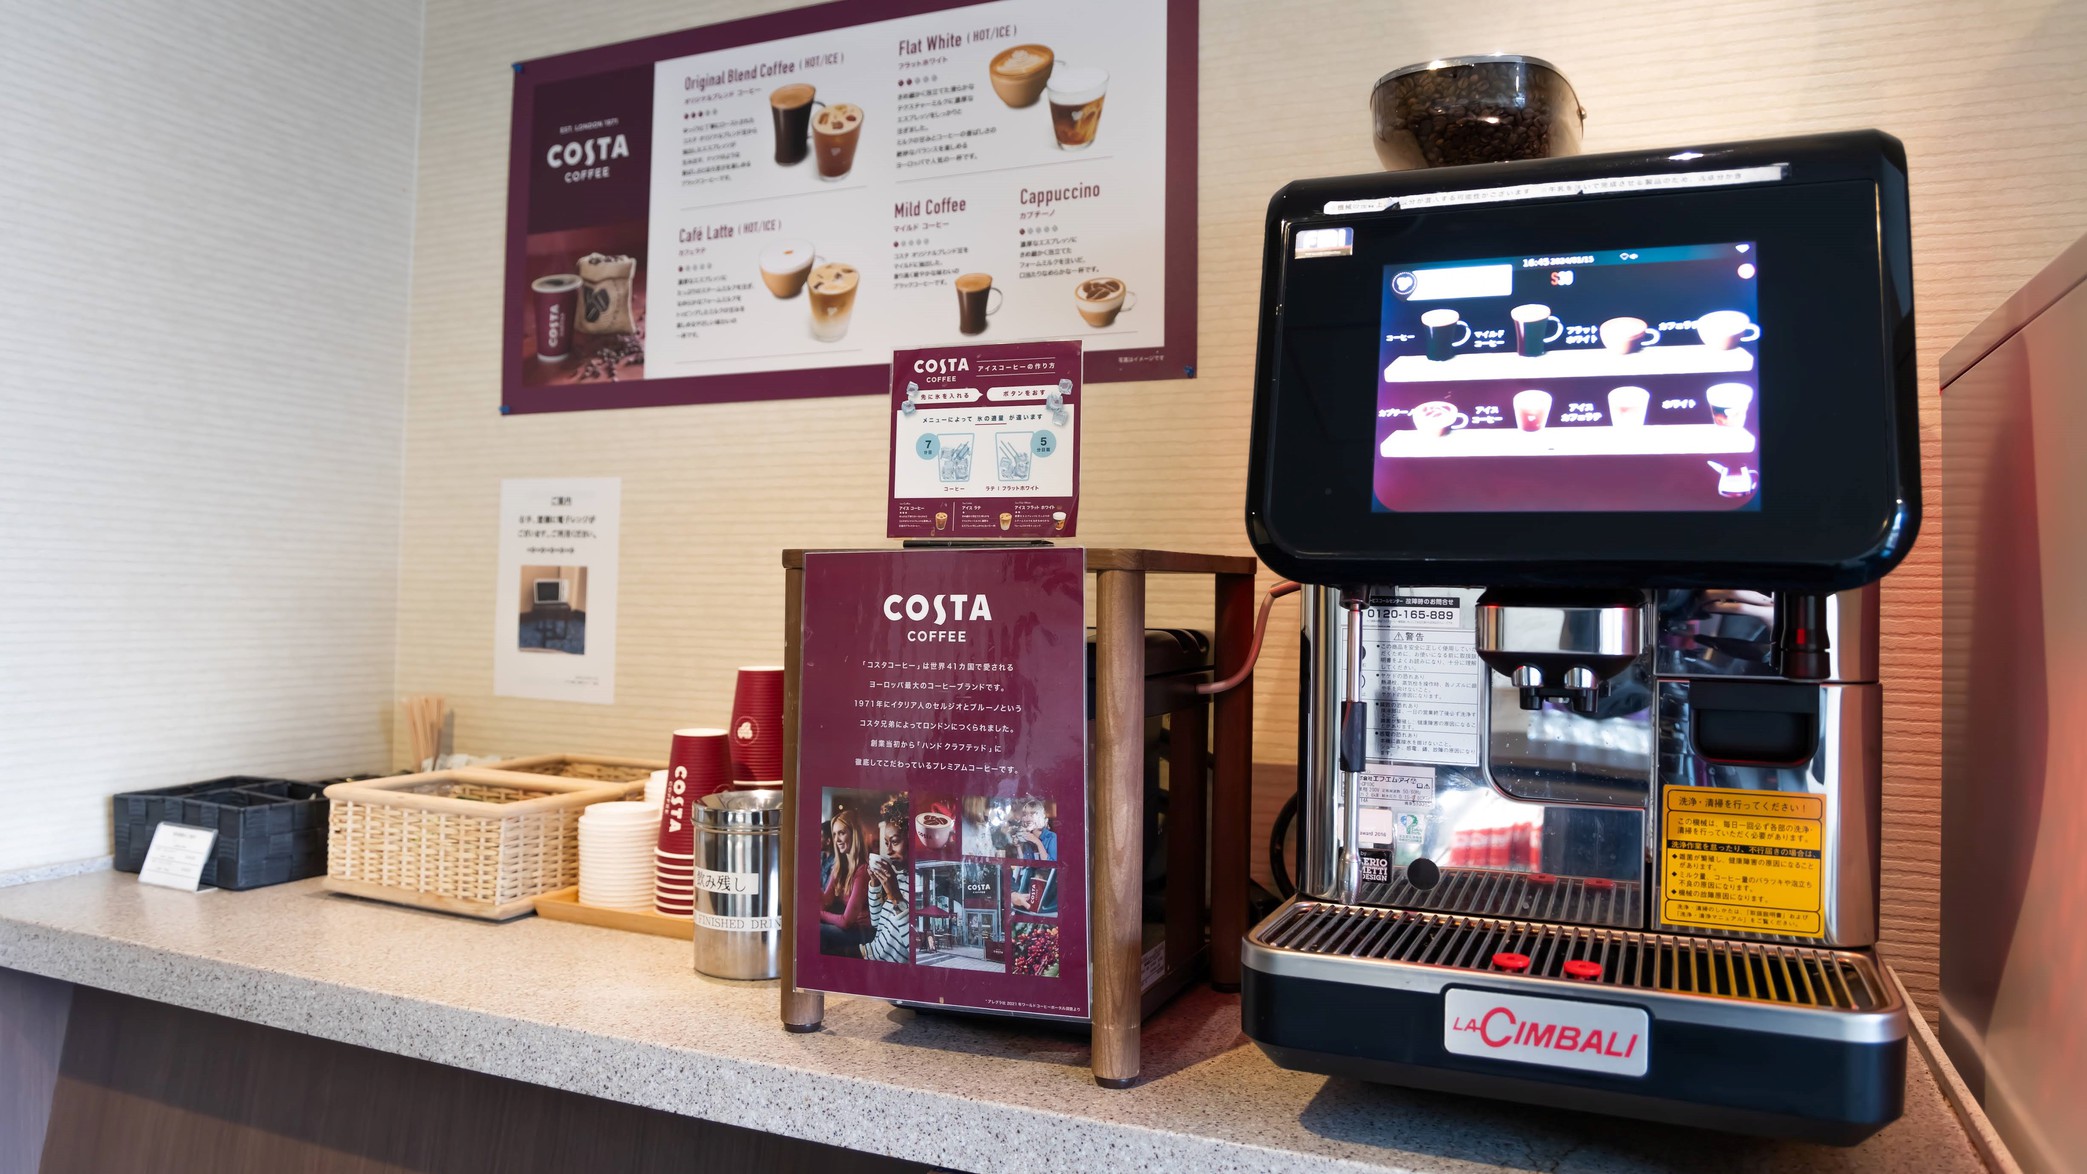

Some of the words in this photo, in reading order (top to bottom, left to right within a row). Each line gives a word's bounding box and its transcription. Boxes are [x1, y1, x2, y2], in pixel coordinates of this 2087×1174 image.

[899, 37, 922, 56] Flat
[927, 33, 962, 51] White
[684, 73, 726, 92] Original
[727, 68, 757, 83] Blend
[760, 62, 795, 79] Coffee
[546, 134, 630, 169] COSTA
[564, 166, 610, 184] COFFEE
[1020, 182, 1100, 209] Cappuccino
[894, 201, 921, 219] Mild
[925, 197, 966, 216] Coffee
[894, 223, 920, 233] マイルド
[922, 221, 950, 230] コーヒー
[679, 225, 702, 244] Café
[706, 223, 734, 241] Latte
[1473, 329, 1506, 339] マイルド
[1565, 325, 1598, 335] フラット
[1385, 333, 1416, 342] コーヒー
[1473, 339, 1506, 348] コーヒー
[1565, 334, 1598, 345] ホワイト
[913, 357, 970, 374] COSTA
[977, 362, 1056, 372] アイスコーヒーの作り方
[926, 375, 957, 383] COFFEE
[920, 392, 970, 401] 先に氷を入れる
[1002, 389, 1046, 397] ボタンをおす
[1474, 405, 1500, 415] アイス
[1568, 402, 1595, 413] アイス
[1661, 398, 1697, 410] ホワイト
[922, 415, 973, 424] メニューによって
[1009, 413, 1043, 421] が違います
[1471, 415, 1504, 424] コーヒー
[925, 440, 932, 449] 7
[1040, 437, 1047, 446] 5
[1405, 598, 1454, 606] 故障時のお問合せ
[883, 594, 992, 626] COSTA
[1367, 608, 1454, 620] 0120-165-889
[907, 630, 966, 642] COFFEE
[1405, 632, 1425, 642] 警告
[869, 680, 1006, 692] ヨーロッパ最大のコーヒーブランドです。
[859, 719, 1015, 734] コスタ兄弟によってロンドンにつくられました。
[855, 758, 1019, 775] 徹底してこだわっているプレミアムコーヒーです。
[668, 765, 688, 833] COSTA
[1678, 796, 1808, 812] 洗浄・清掃を行ってください！
[1362, 857, 1388, 867] ERIO
[697, 871, 746, 892] 飲み残し
[967, 883, 991, 891] COSTA
[696, 914, 745, 929] FINISHED
[751, 918, 781, 929] DRIN
[1453, 1017, 1477, 1032] LA
[1480, 1006, 1639, 1058] CIMBALI
